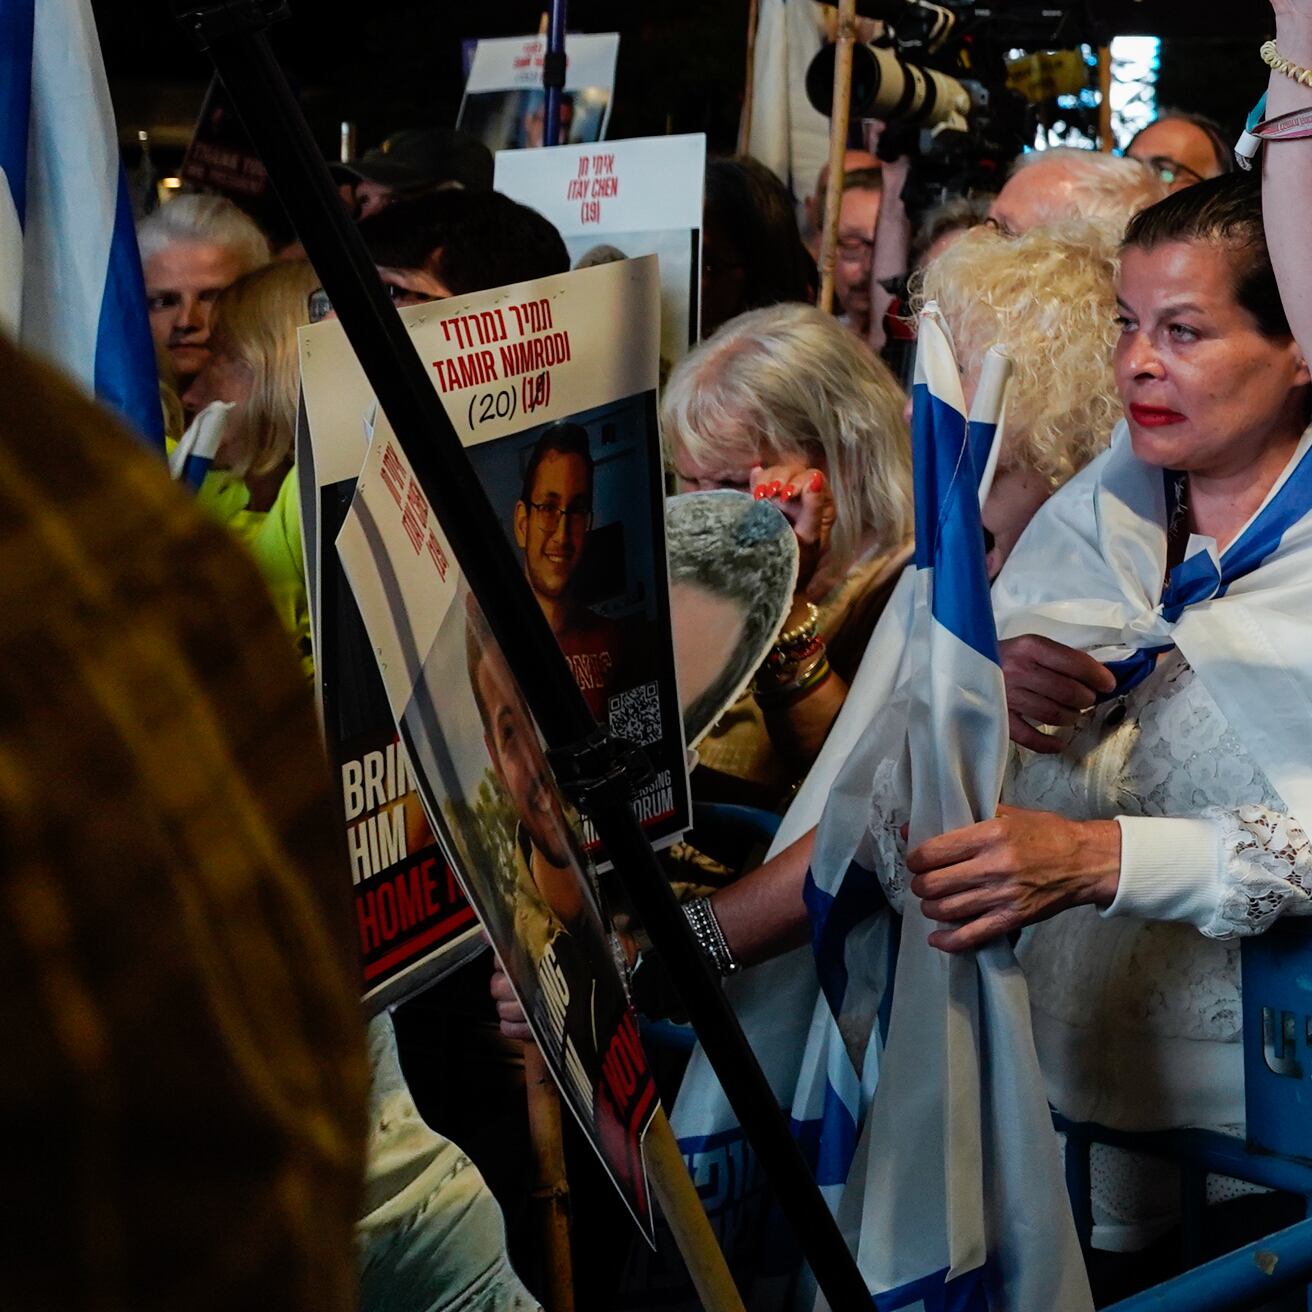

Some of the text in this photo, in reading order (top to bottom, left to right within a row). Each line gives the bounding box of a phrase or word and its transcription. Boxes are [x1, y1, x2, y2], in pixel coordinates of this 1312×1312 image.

[567, 177, 618, 200] ITAY CHEN
[581, 200, 600, 224] (19)
[440, 299, 553, 349] תמיר נמרודי
[432, 331, 571, 393] TAMIR NIMRODI
[468, 385, 517, 431] (20)
[341, 740, 417, 822] BRIN
[632, 787, 674, 823] ORUM
[347, 803, 408, 887] HIM
[355, 855, 442, 955] HOME
